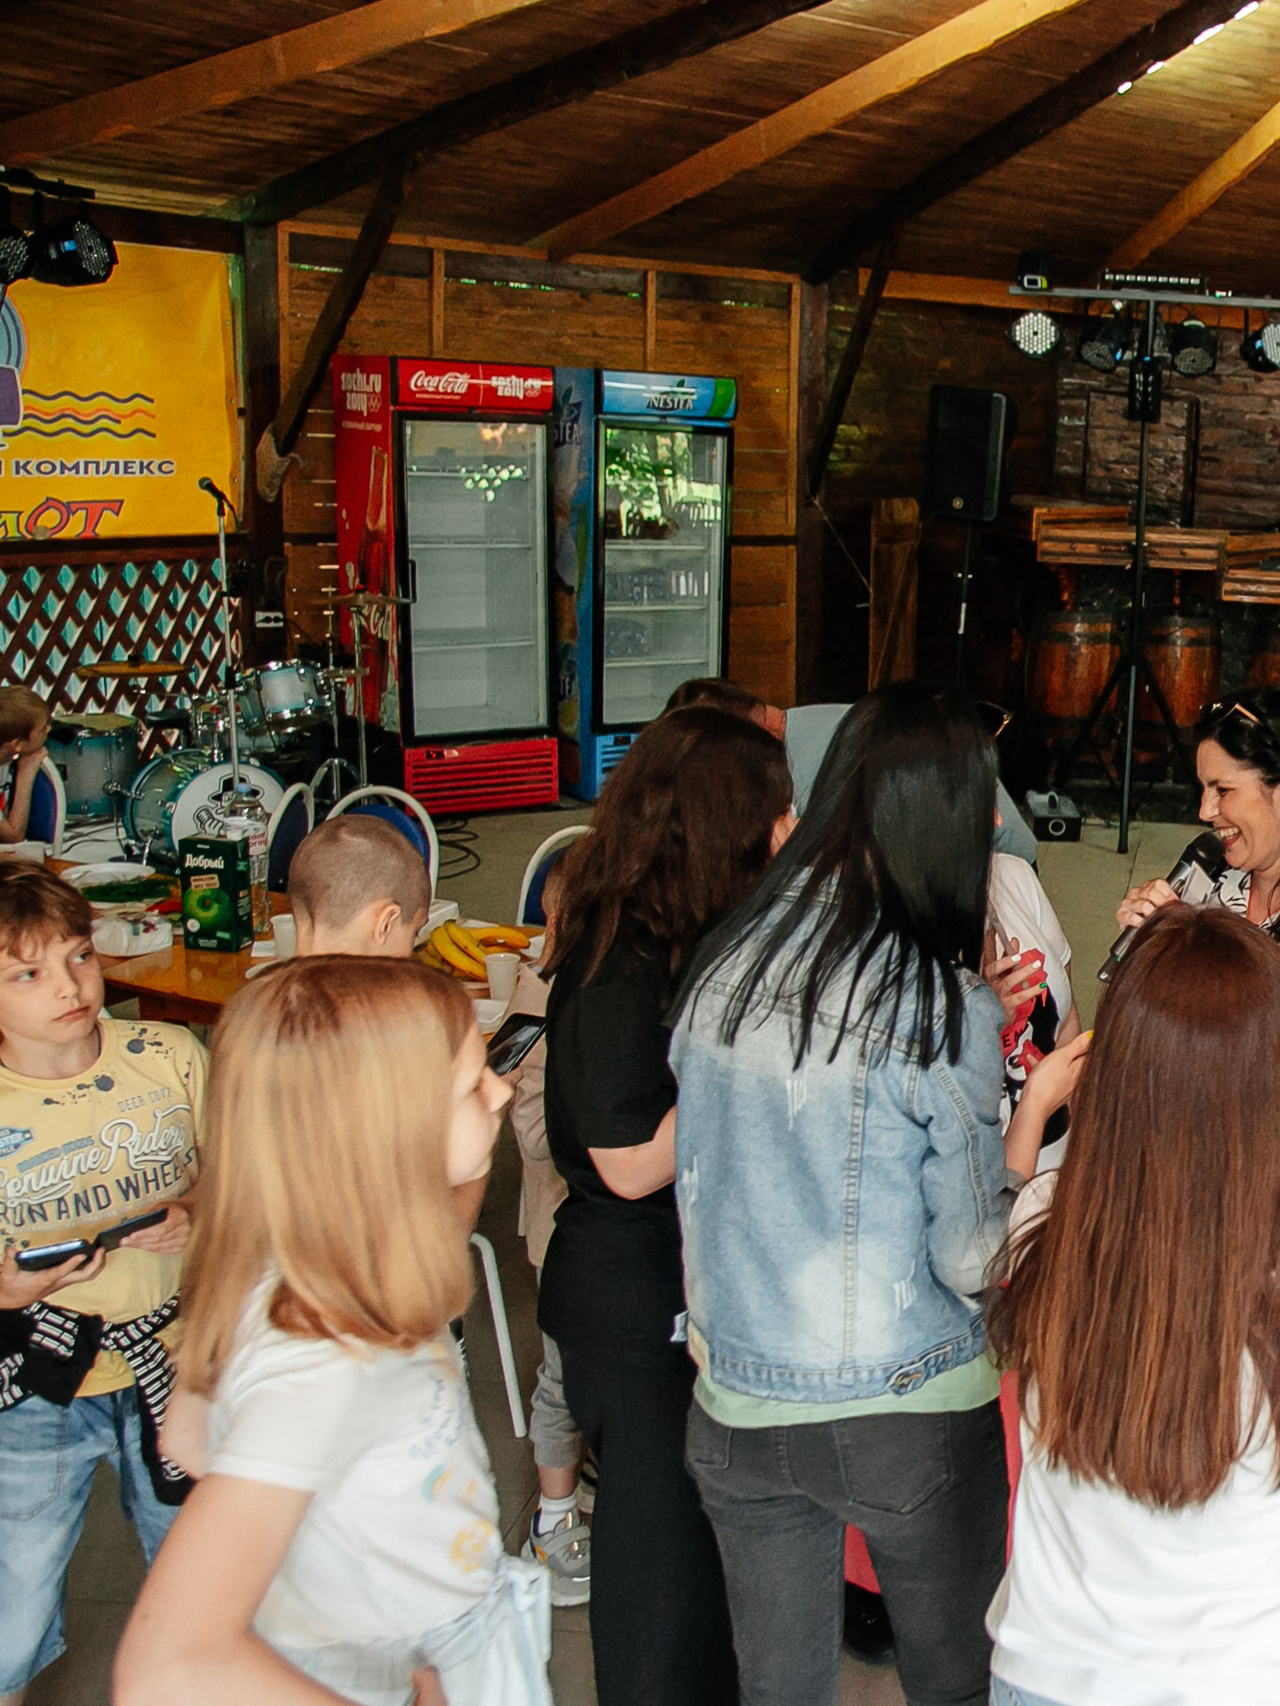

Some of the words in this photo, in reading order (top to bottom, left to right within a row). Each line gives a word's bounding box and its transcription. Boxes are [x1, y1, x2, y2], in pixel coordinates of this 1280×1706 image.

[13, 459, 176, 476] КОМПЛЕКС
[185, 853, 225, 869] Добрый
[57, 1184, 113, 1220] AND
